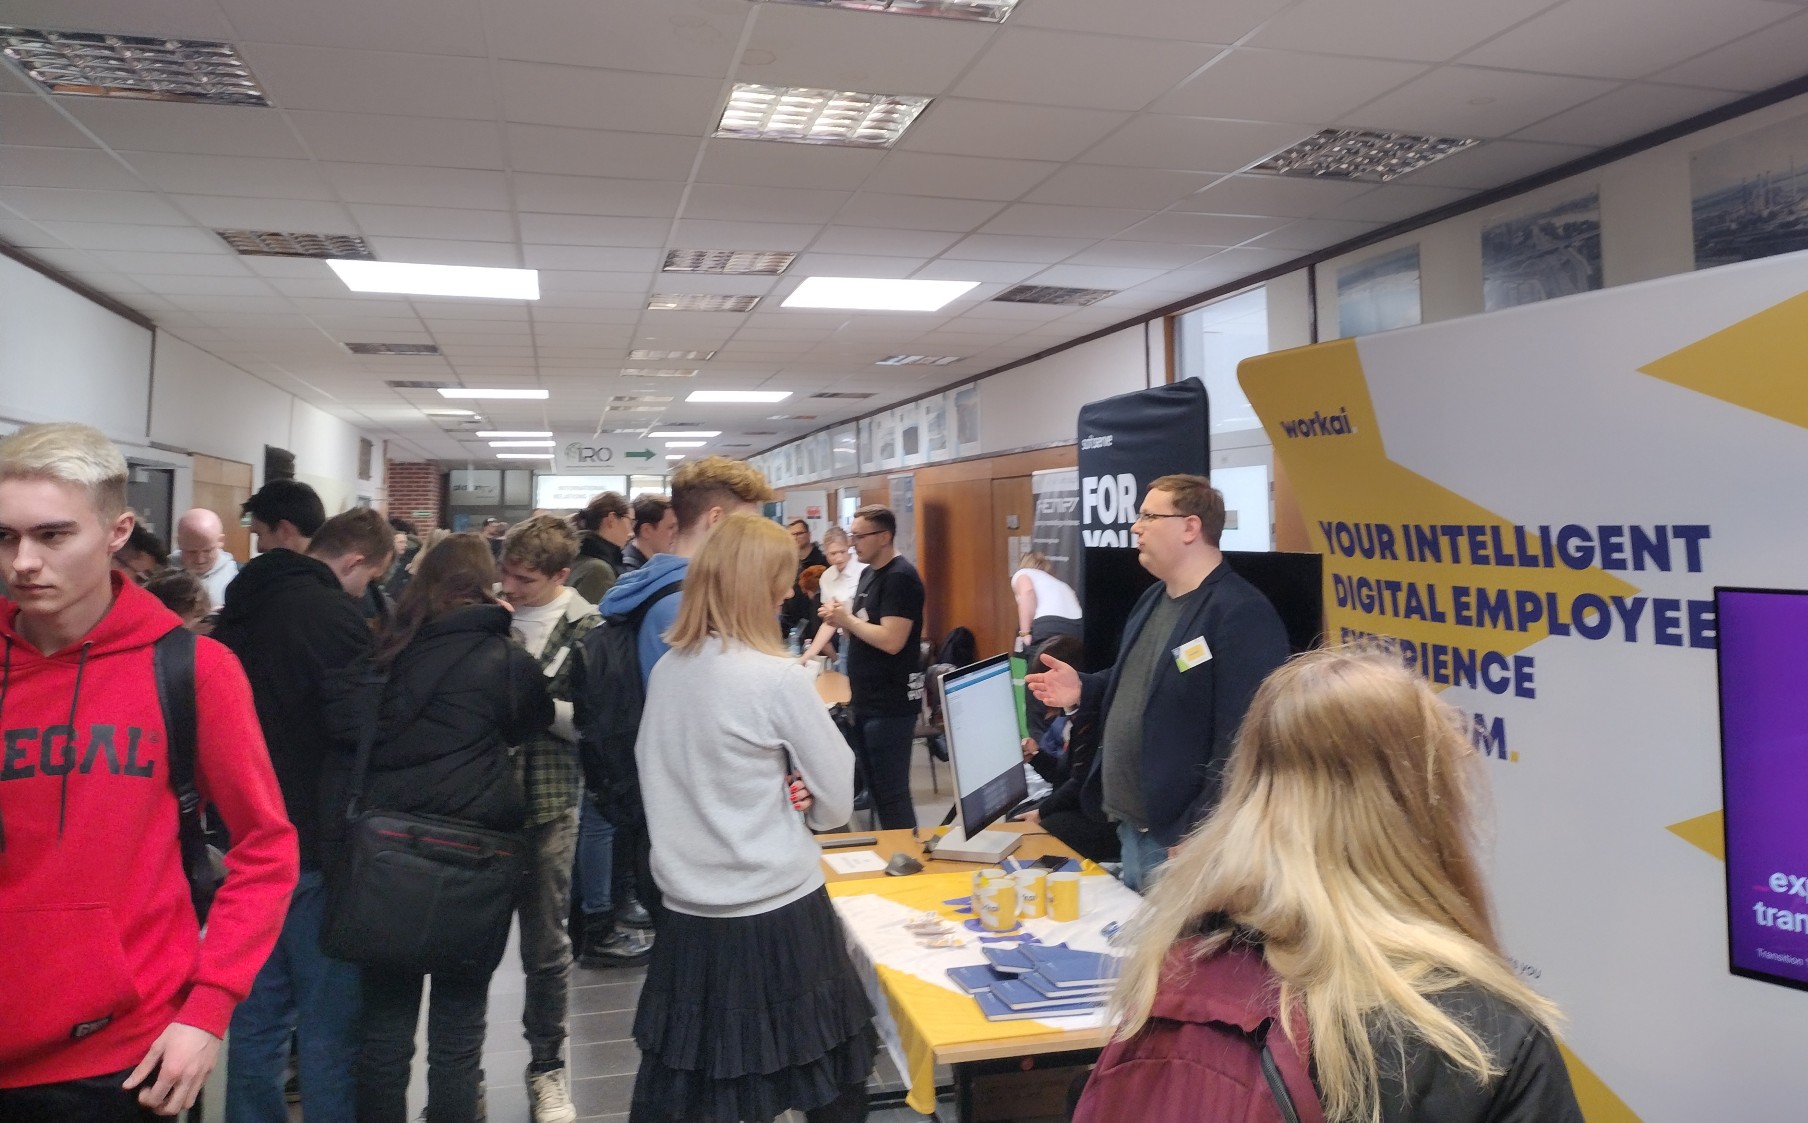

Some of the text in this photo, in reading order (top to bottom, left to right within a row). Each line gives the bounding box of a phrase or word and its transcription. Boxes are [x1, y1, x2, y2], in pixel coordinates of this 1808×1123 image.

[1082, 473, 1138, 525] FOR
[1318, 520, 1712, 574] YOUR INTELLIGENT
[1332, 572, 1718, 650] DIGITAL EMPLOYEE
